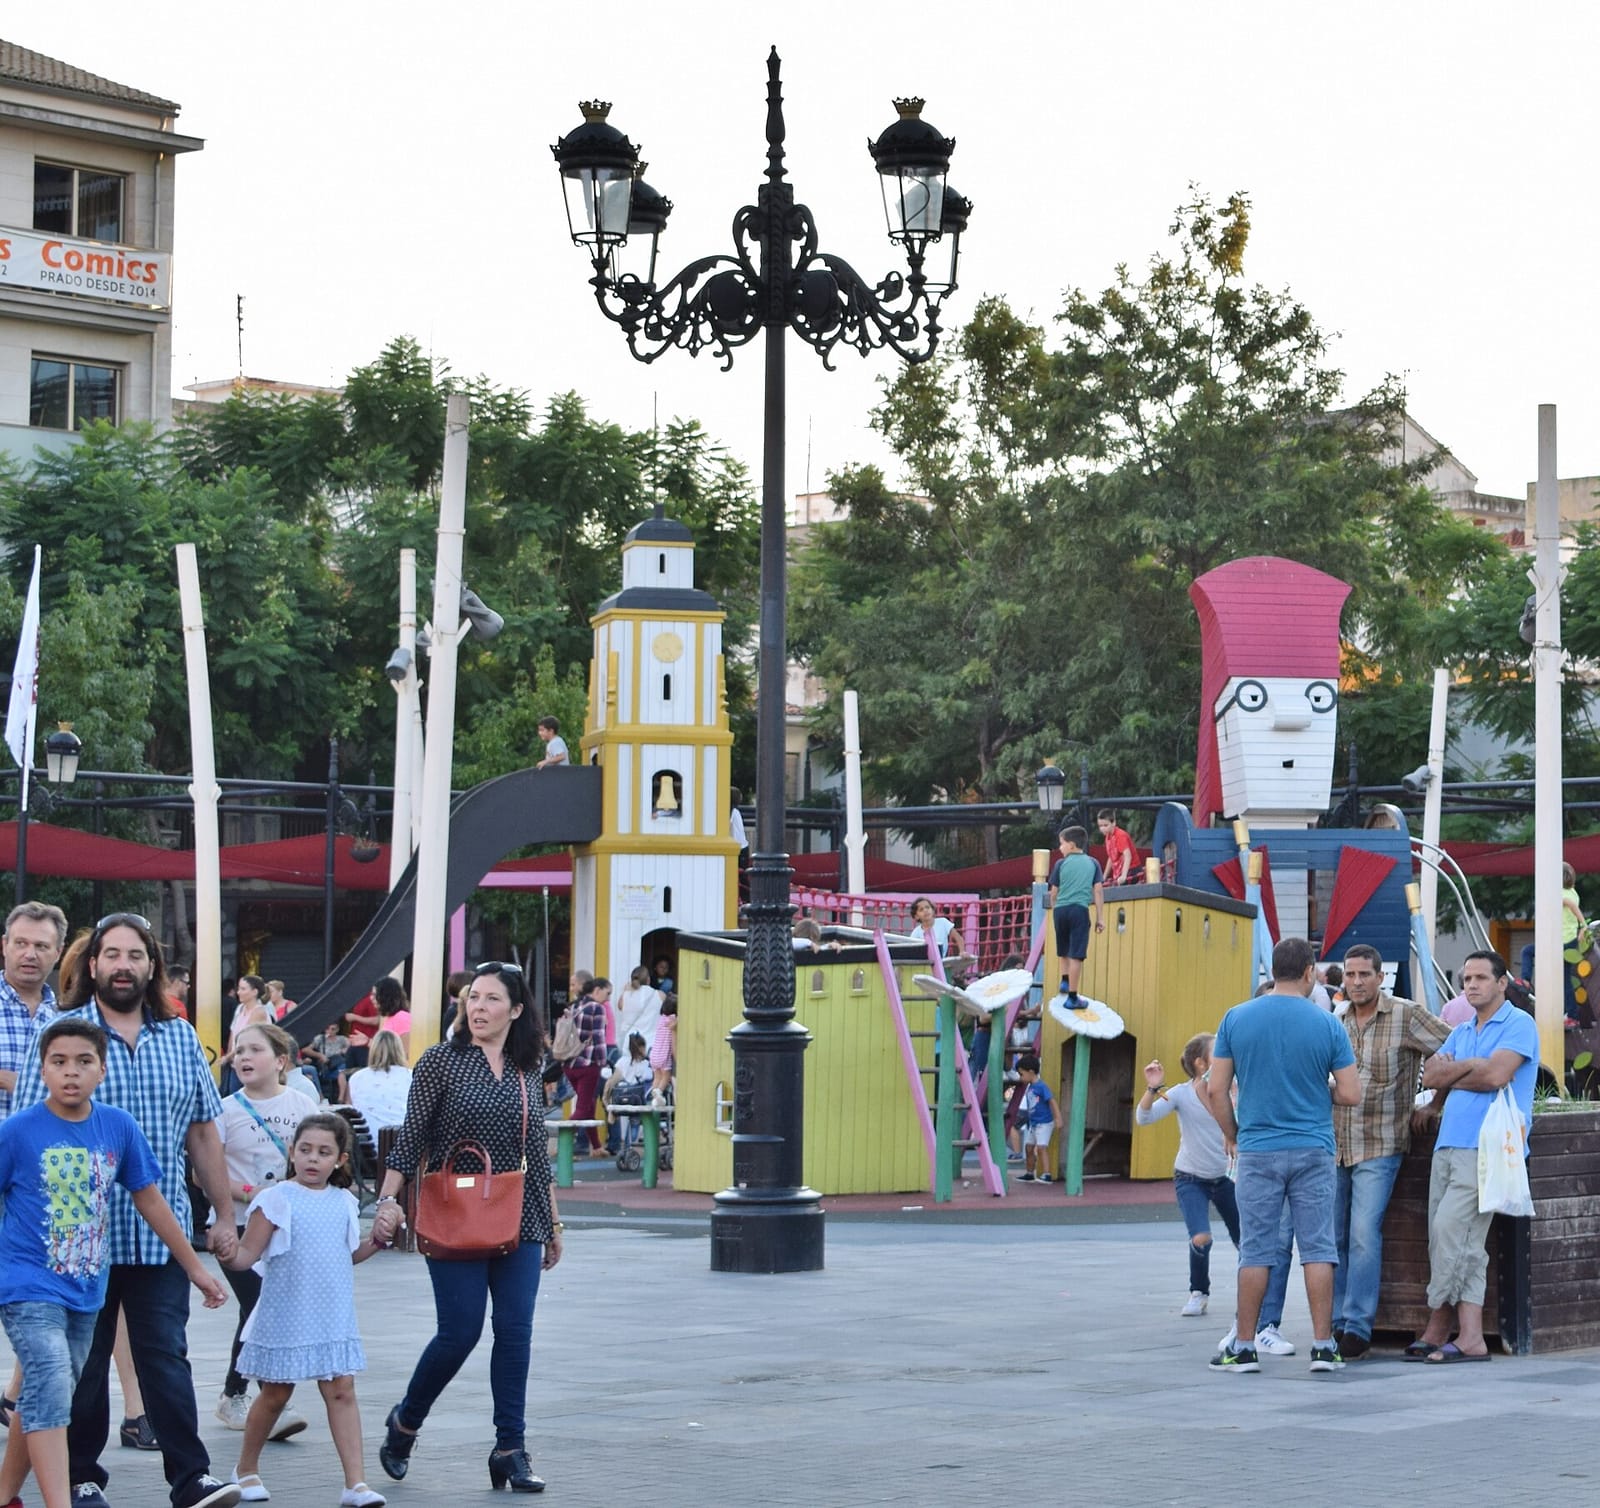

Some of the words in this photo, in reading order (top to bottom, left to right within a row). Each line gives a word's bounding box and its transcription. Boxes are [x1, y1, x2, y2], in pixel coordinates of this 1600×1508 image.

[42, 240, 158, 284] Comics
[40, 270, 82, 287] PRADO
[86, 277, 126, 294] DESDE
[129, 284, 156, 297] 2014
